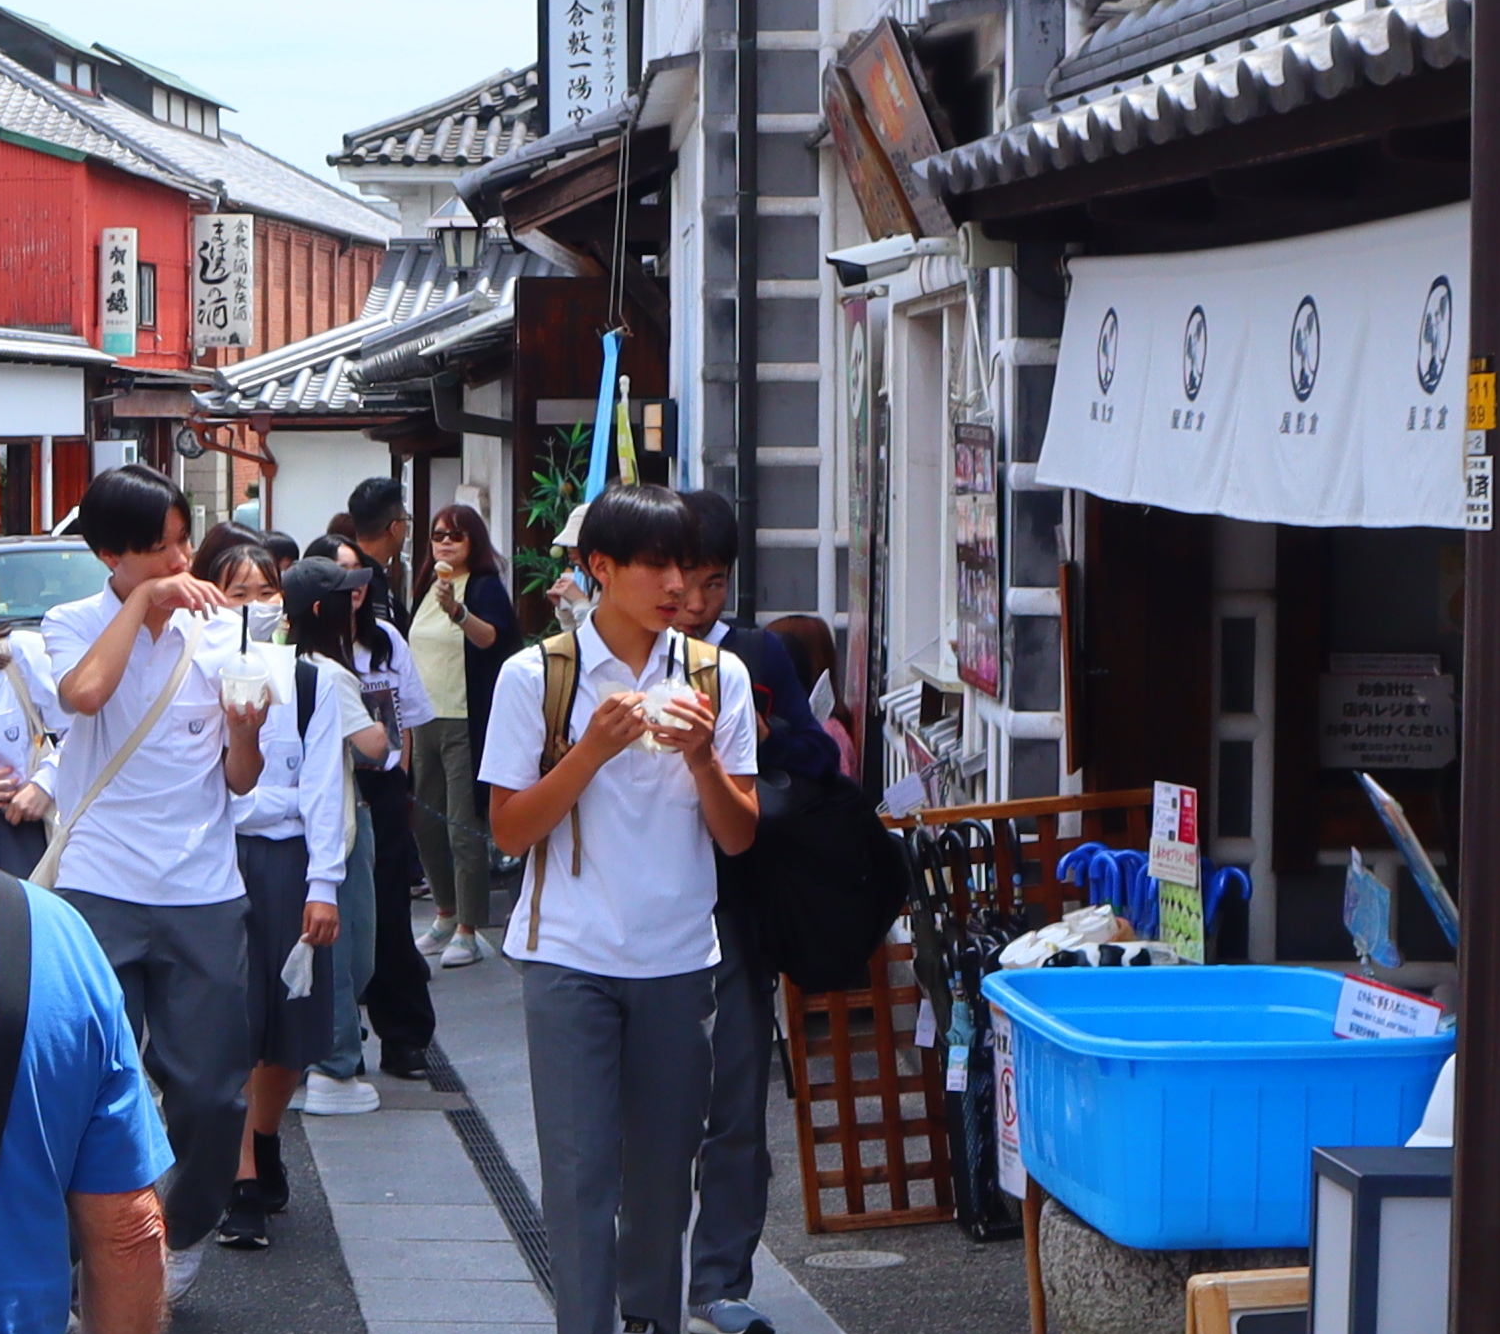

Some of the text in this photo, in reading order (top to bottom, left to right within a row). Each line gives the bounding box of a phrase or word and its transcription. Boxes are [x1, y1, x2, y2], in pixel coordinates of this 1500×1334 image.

[1342, 702, 1431, 717] 店内レジまで
